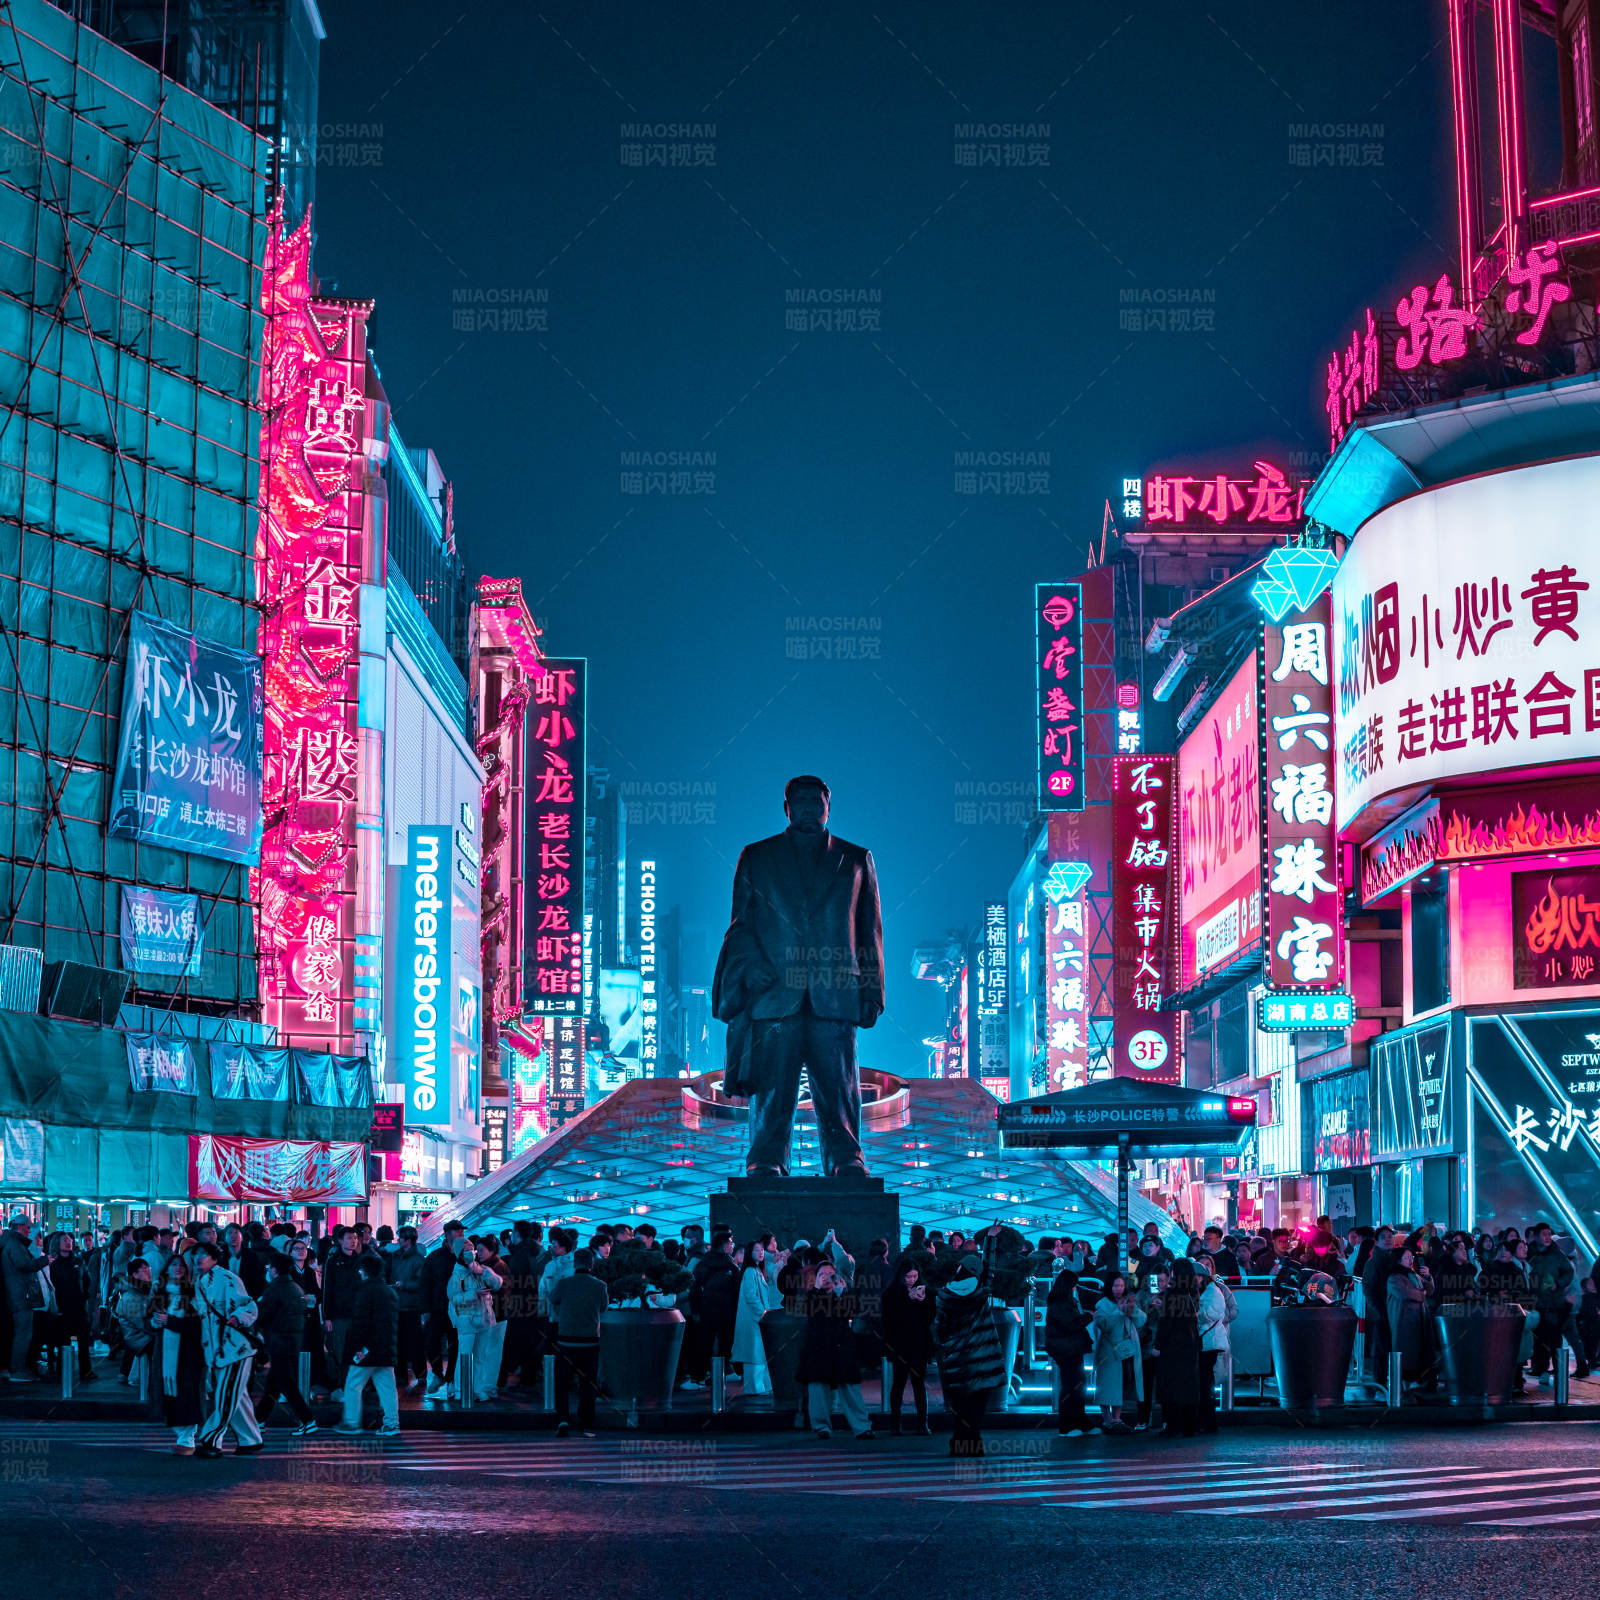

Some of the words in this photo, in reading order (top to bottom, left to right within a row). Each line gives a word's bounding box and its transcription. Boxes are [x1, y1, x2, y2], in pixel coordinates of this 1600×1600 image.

[1123, 478, 1141, 518] 四楼
[1147, 460, 1304, 522] 虾小龙
[130, 730, 247, 797] 老长沙龙虾馆
[1050, 776, 1072, 791] 2F
[180, 801, 247, 836] 请上本栋三楼
[1126, 763, 1168, 868] 不了锅
[1271, 622, 1337, 982] 周六福珠宝
[131, 902, 199, 941] 傣妹火锅
[987, 904, 1006, 988] 美栖酒店
[1132, 883, 1162, 1012] 集市火锅
[414, 836, 443, 1111] metersbonwe
[988, 990, 1006, 1003] 5F
[1050, 902, 1087, 1090] 周六福珠宝
[534, 1000, 576, 1012] 请上二楼
[1267, 1001, 1350, 1022] 湖南总店
[1135, 1041, 1163, 1061] 3F
